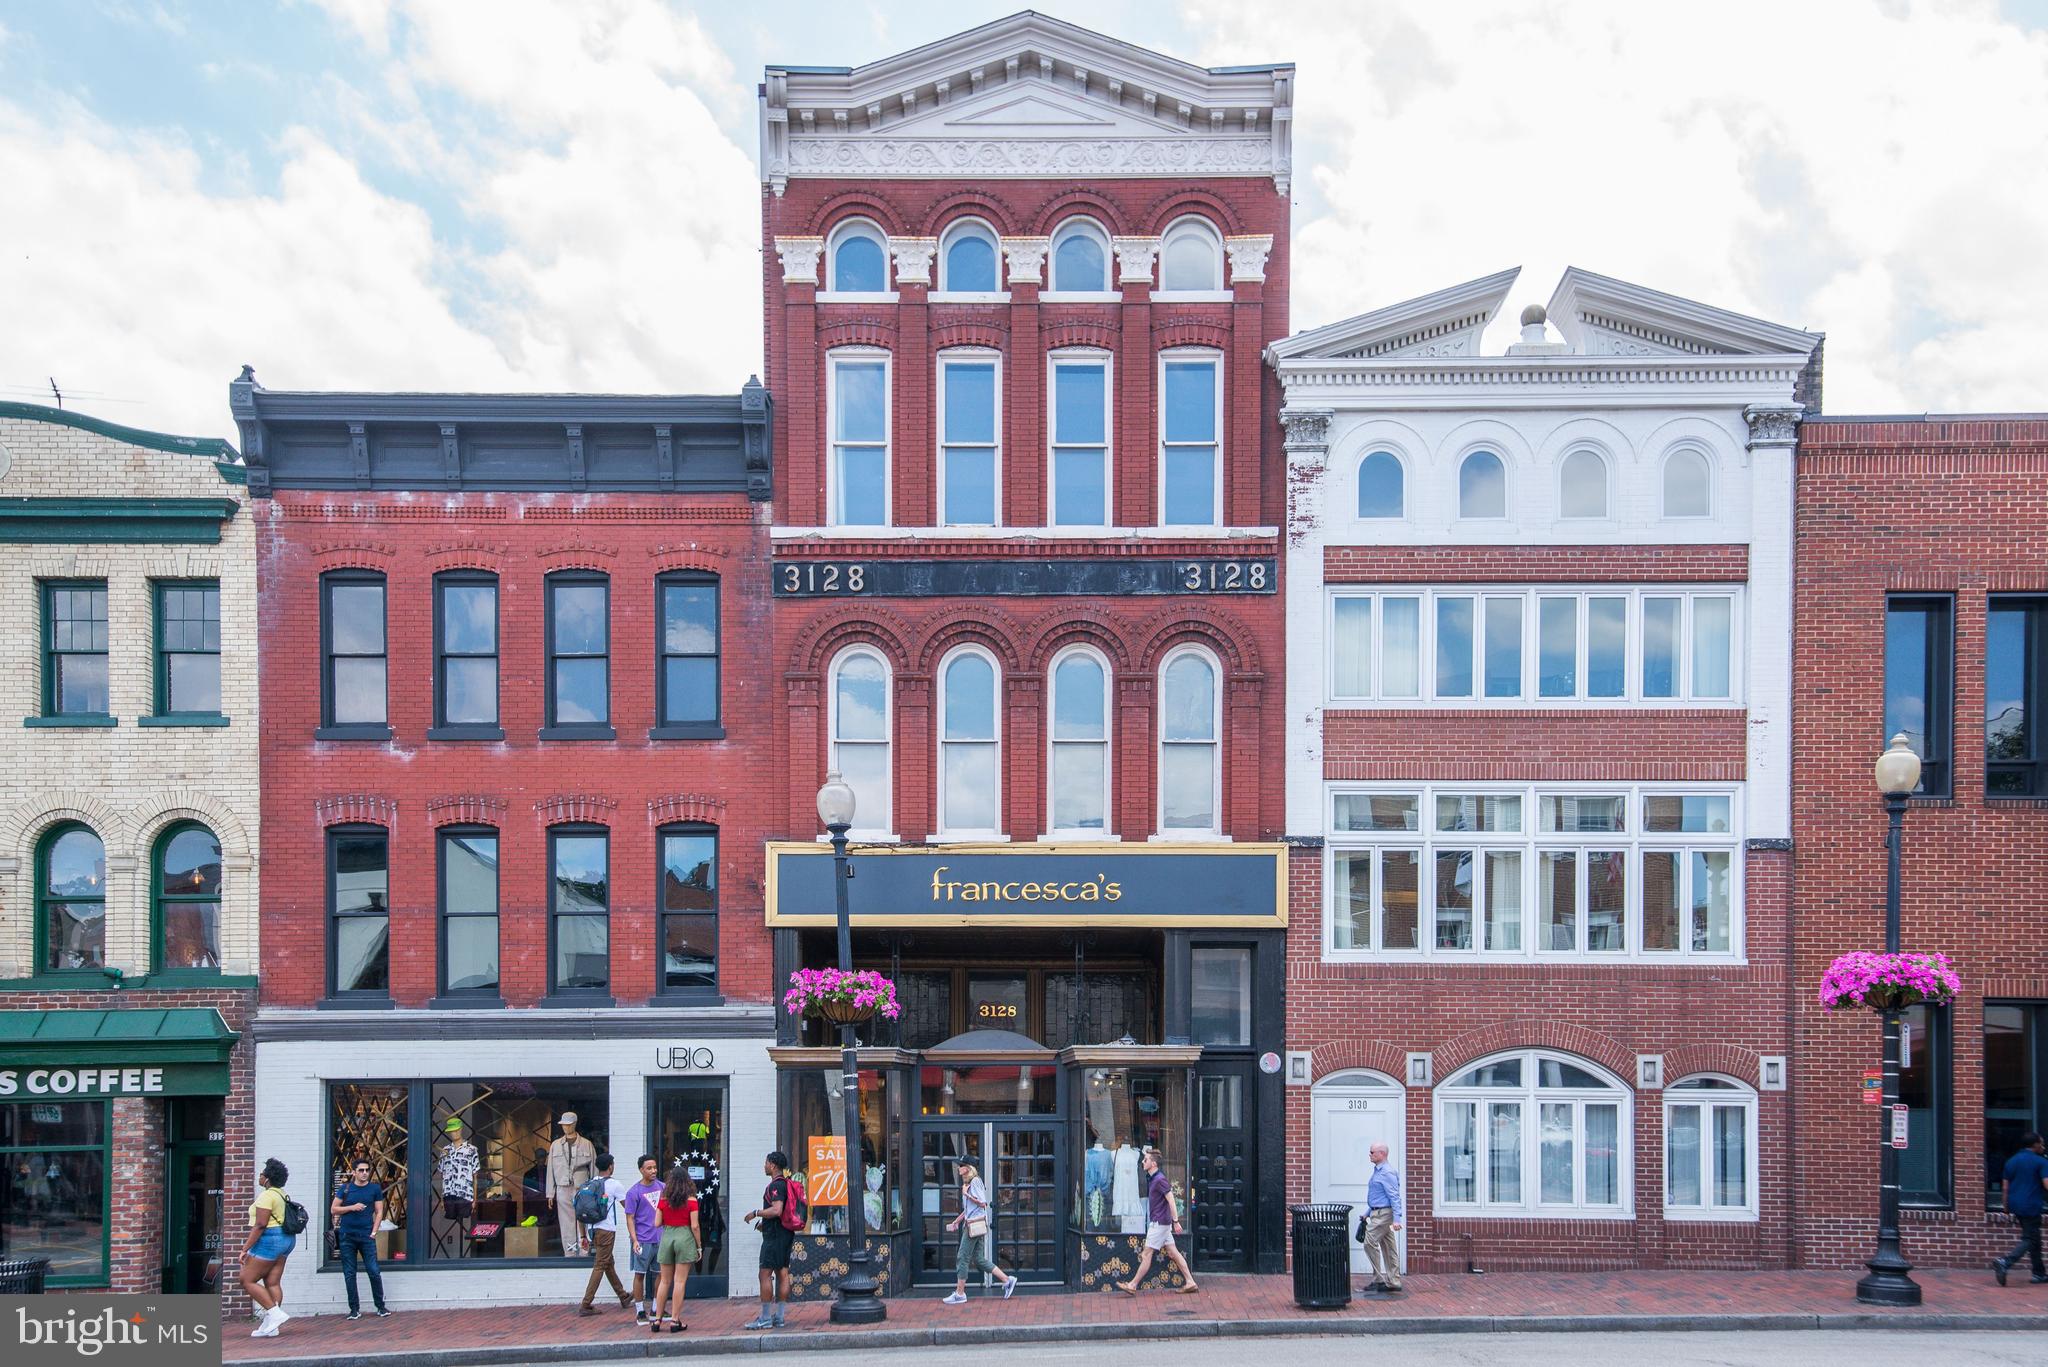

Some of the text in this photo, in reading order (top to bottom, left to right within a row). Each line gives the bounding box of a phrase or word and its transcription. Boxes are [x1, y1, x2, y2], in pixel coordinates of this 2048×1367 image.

[784, 564, 865, 592] 3128
[1185, 562, 1266, 590] 3128
[930, 866, 1122, 901] francesca's
[979, 1004, 1018, 1017] 3128
[656, 1047, 715, 1069] UBIQ
[26, 1068, 164, 1094] COFFEE
[1348, 1100, 1368, 1110] 3130
[816, 1149, 847, 1161] SAL
